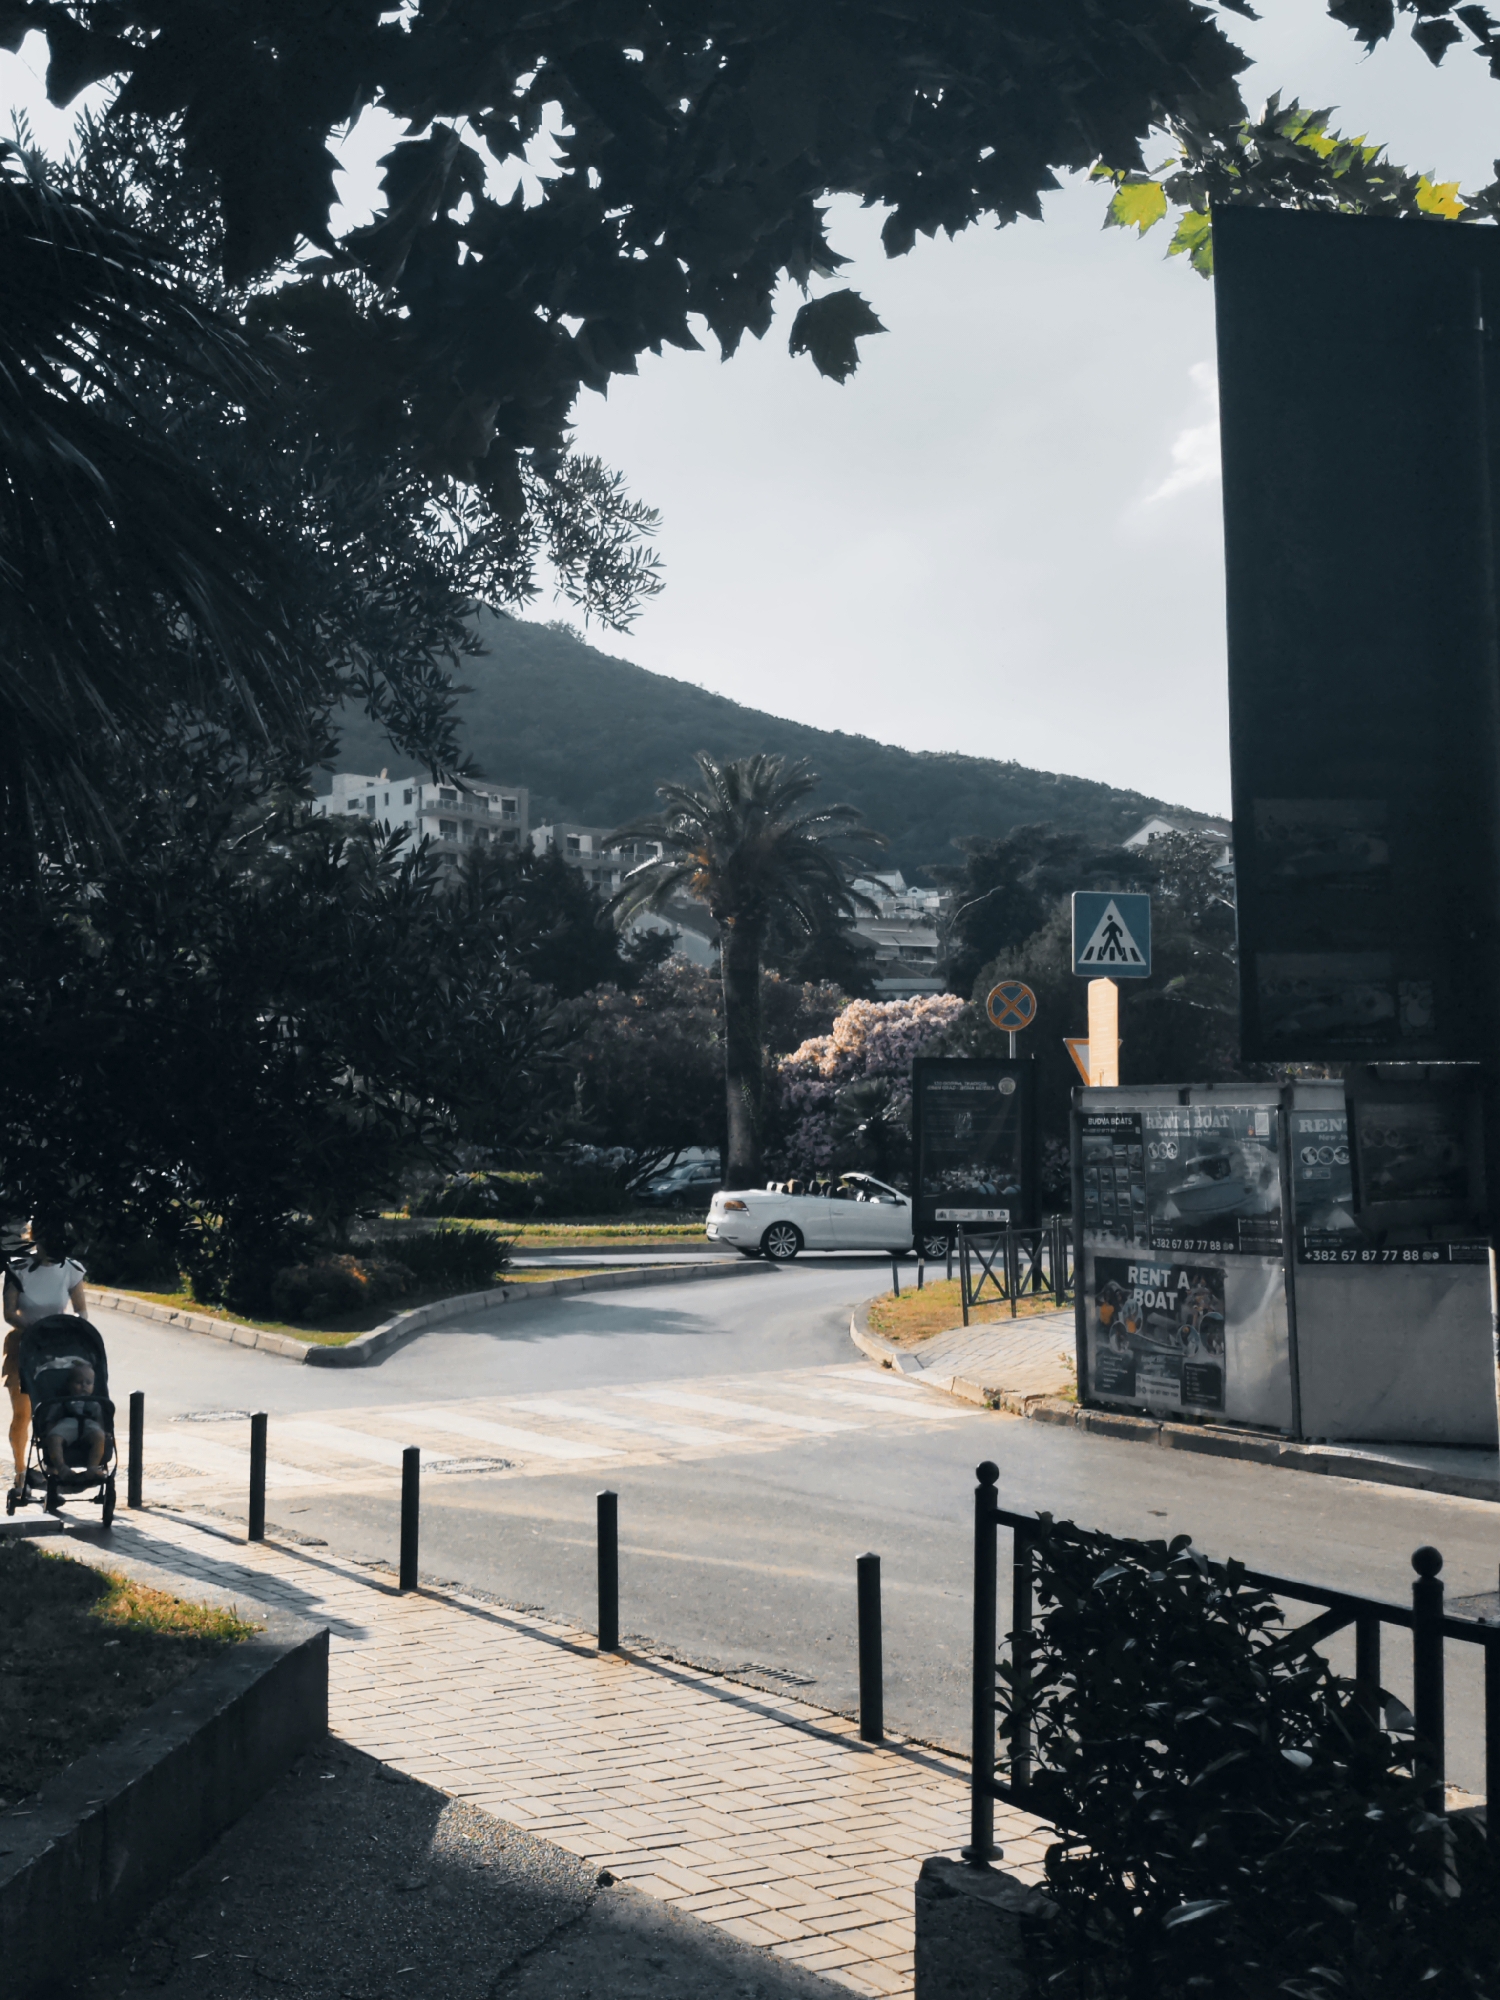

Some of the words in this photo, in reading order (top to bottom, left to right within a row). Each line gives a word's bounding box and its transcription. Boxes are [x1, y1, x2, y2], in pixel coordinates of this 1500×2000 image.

[1110, 1117, 1133, 1126] BOATS
[1145, 1115, 1181, 1129] RENT
[1183, 1118, 1190, 1129] a
[1193, 1114, 1230, 1128] BOAT
[1152, 1238, 1170, 1249] +382
[1171, 1239, 1182, 1249] 67
[1184, 1239, 1194, 1250] 87
[1196, 1240, 1208, 1251] 77
[1209, 1240, 1221, 1251] 88
[1305, 1250, 1337, 1261] +382
[1341, 1250, 1357, 1261] 67
[1361, 1250, 1377, 1261] 87
[1381, 1250, 1398, 1261] 77
[1402, 1250, 1419, 1261] 88
[1128, 1265, 1171, 1288] RENT
[1177, 1271, 1190, 1290] A
[1133, 1288, 1178, 1311] BOAT
